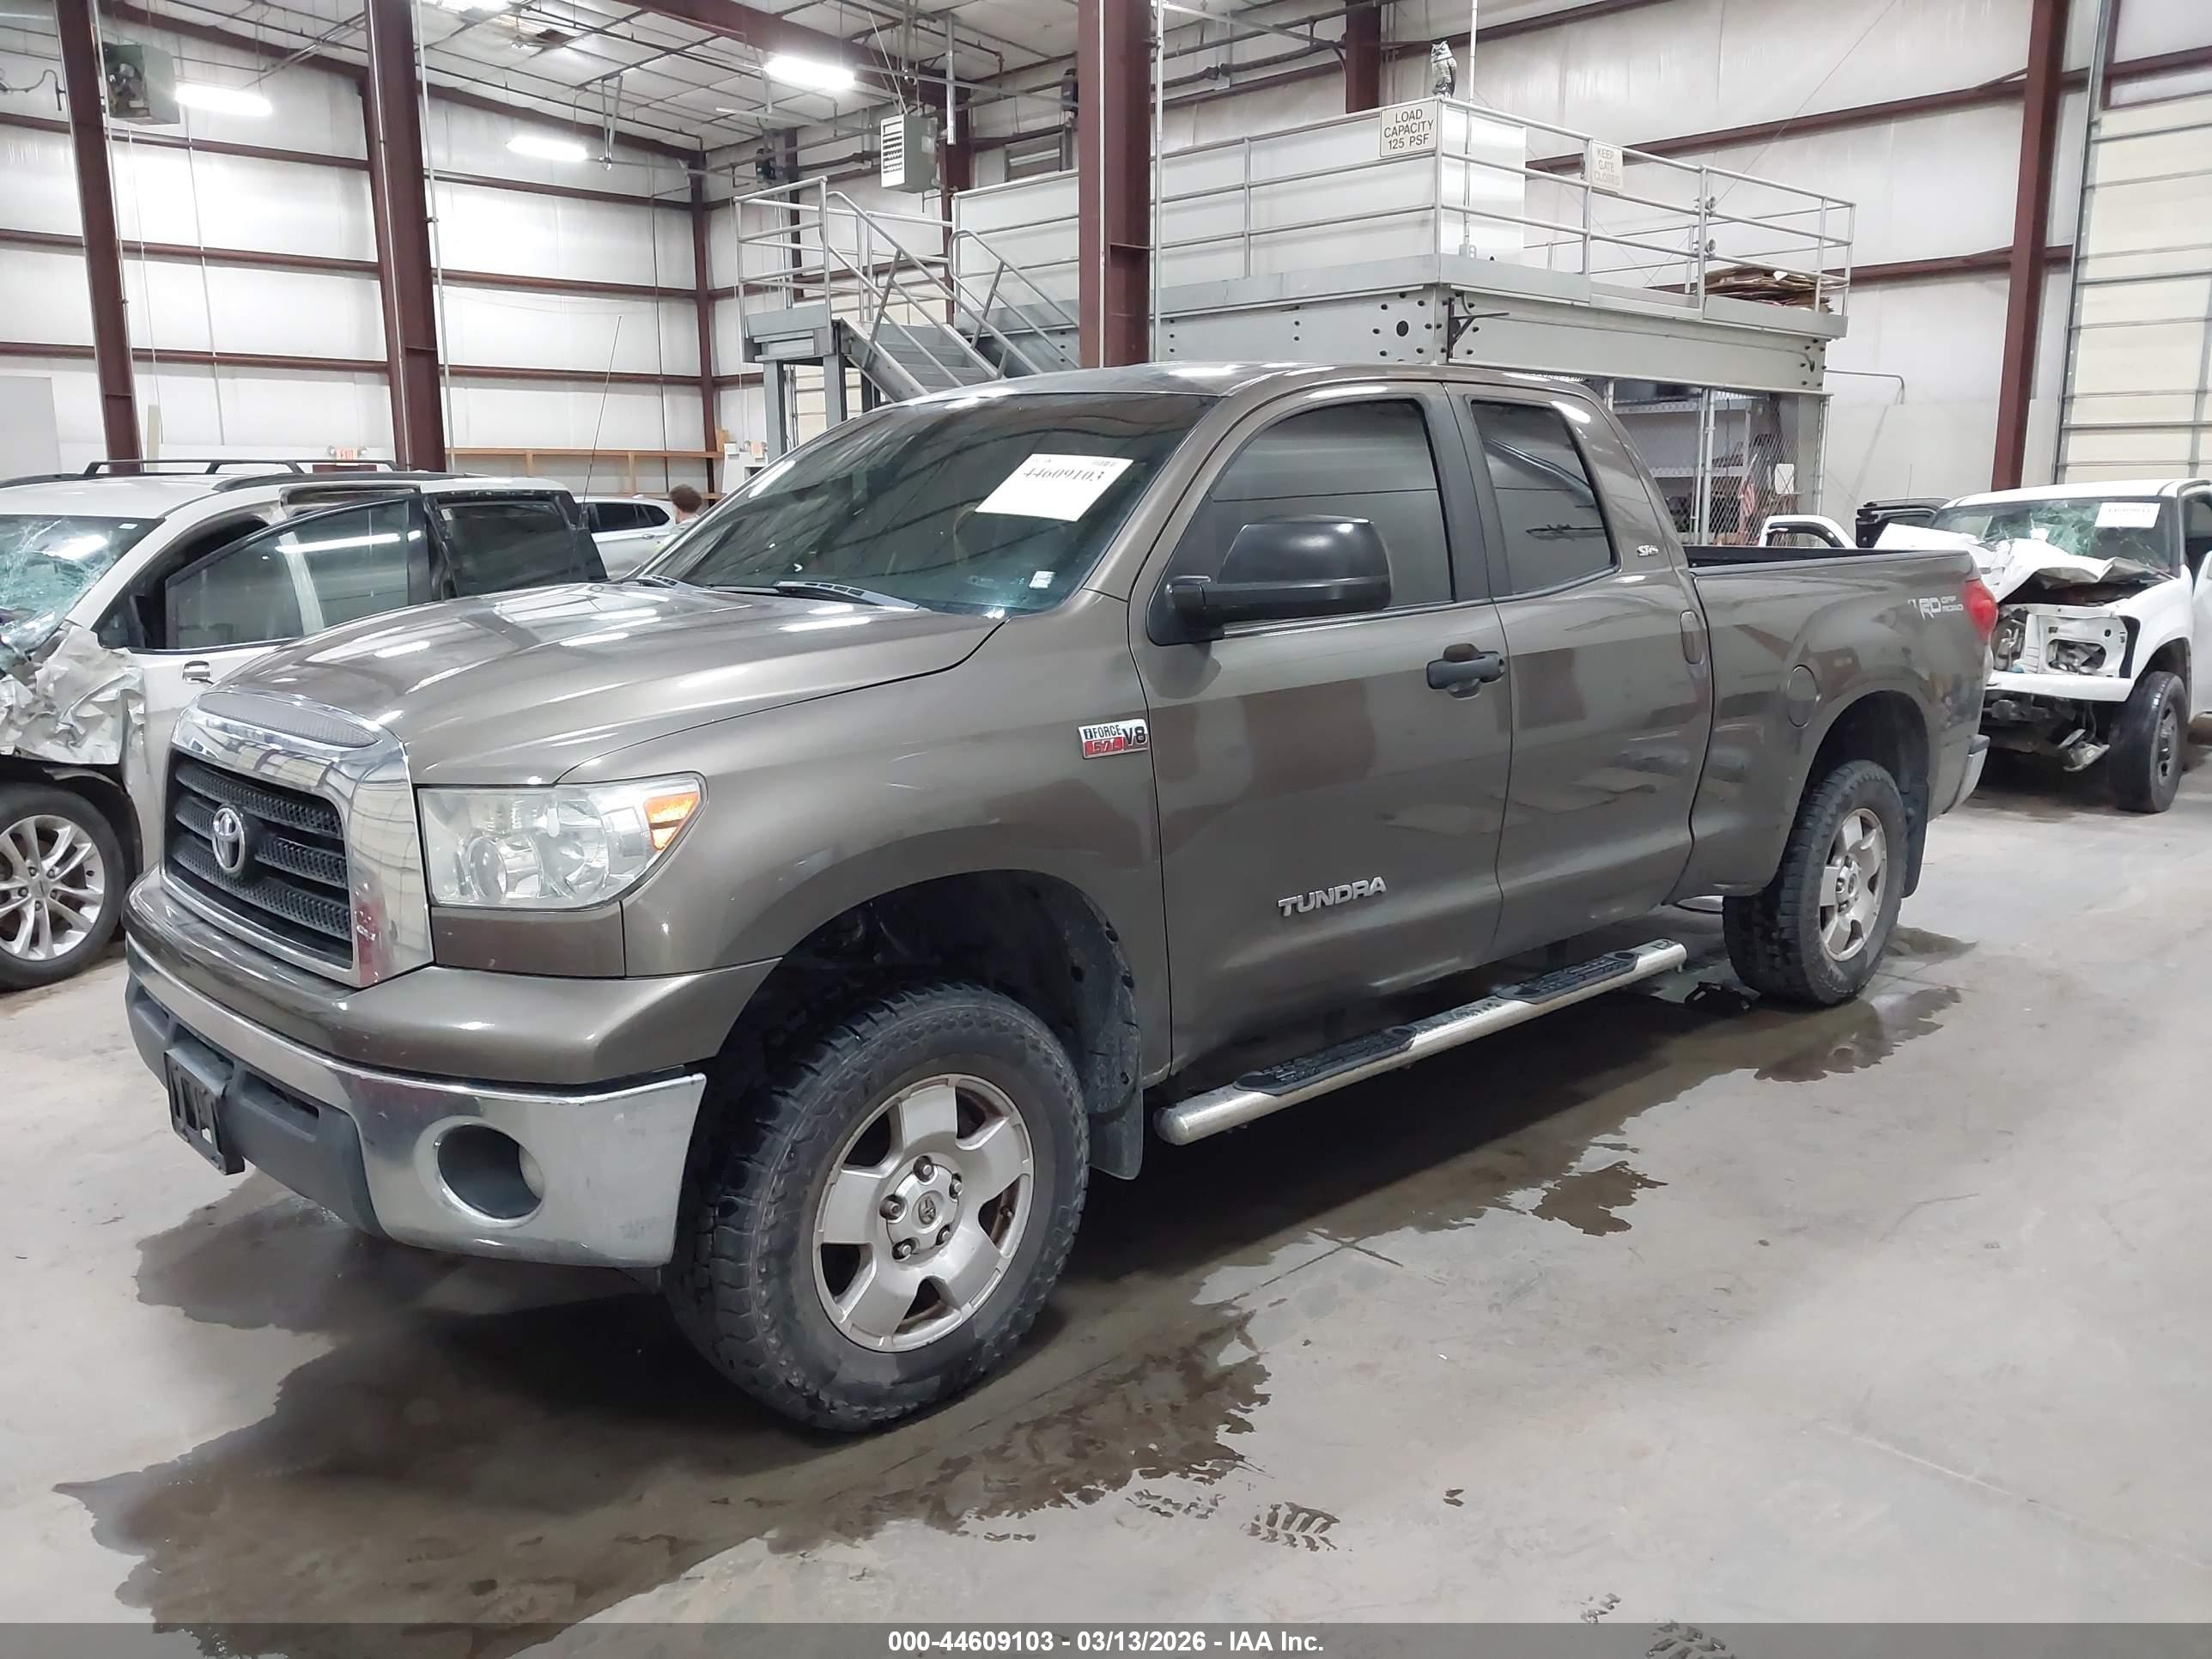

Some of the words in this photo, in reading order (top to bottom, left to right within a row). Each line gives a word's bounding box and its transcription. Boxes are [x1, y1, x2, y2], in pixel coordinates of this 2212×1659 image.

[1395, 108, 1423, 124] LOAD
[1383, 119, 1434, 138] CAPACITY
[1388, 137, 1405, 150] 125
[1409, 133, 1430, 147] PSF
[1121, 726, 1147, 746] V8
[1277, 876, 1388, 917] TUNDRA
